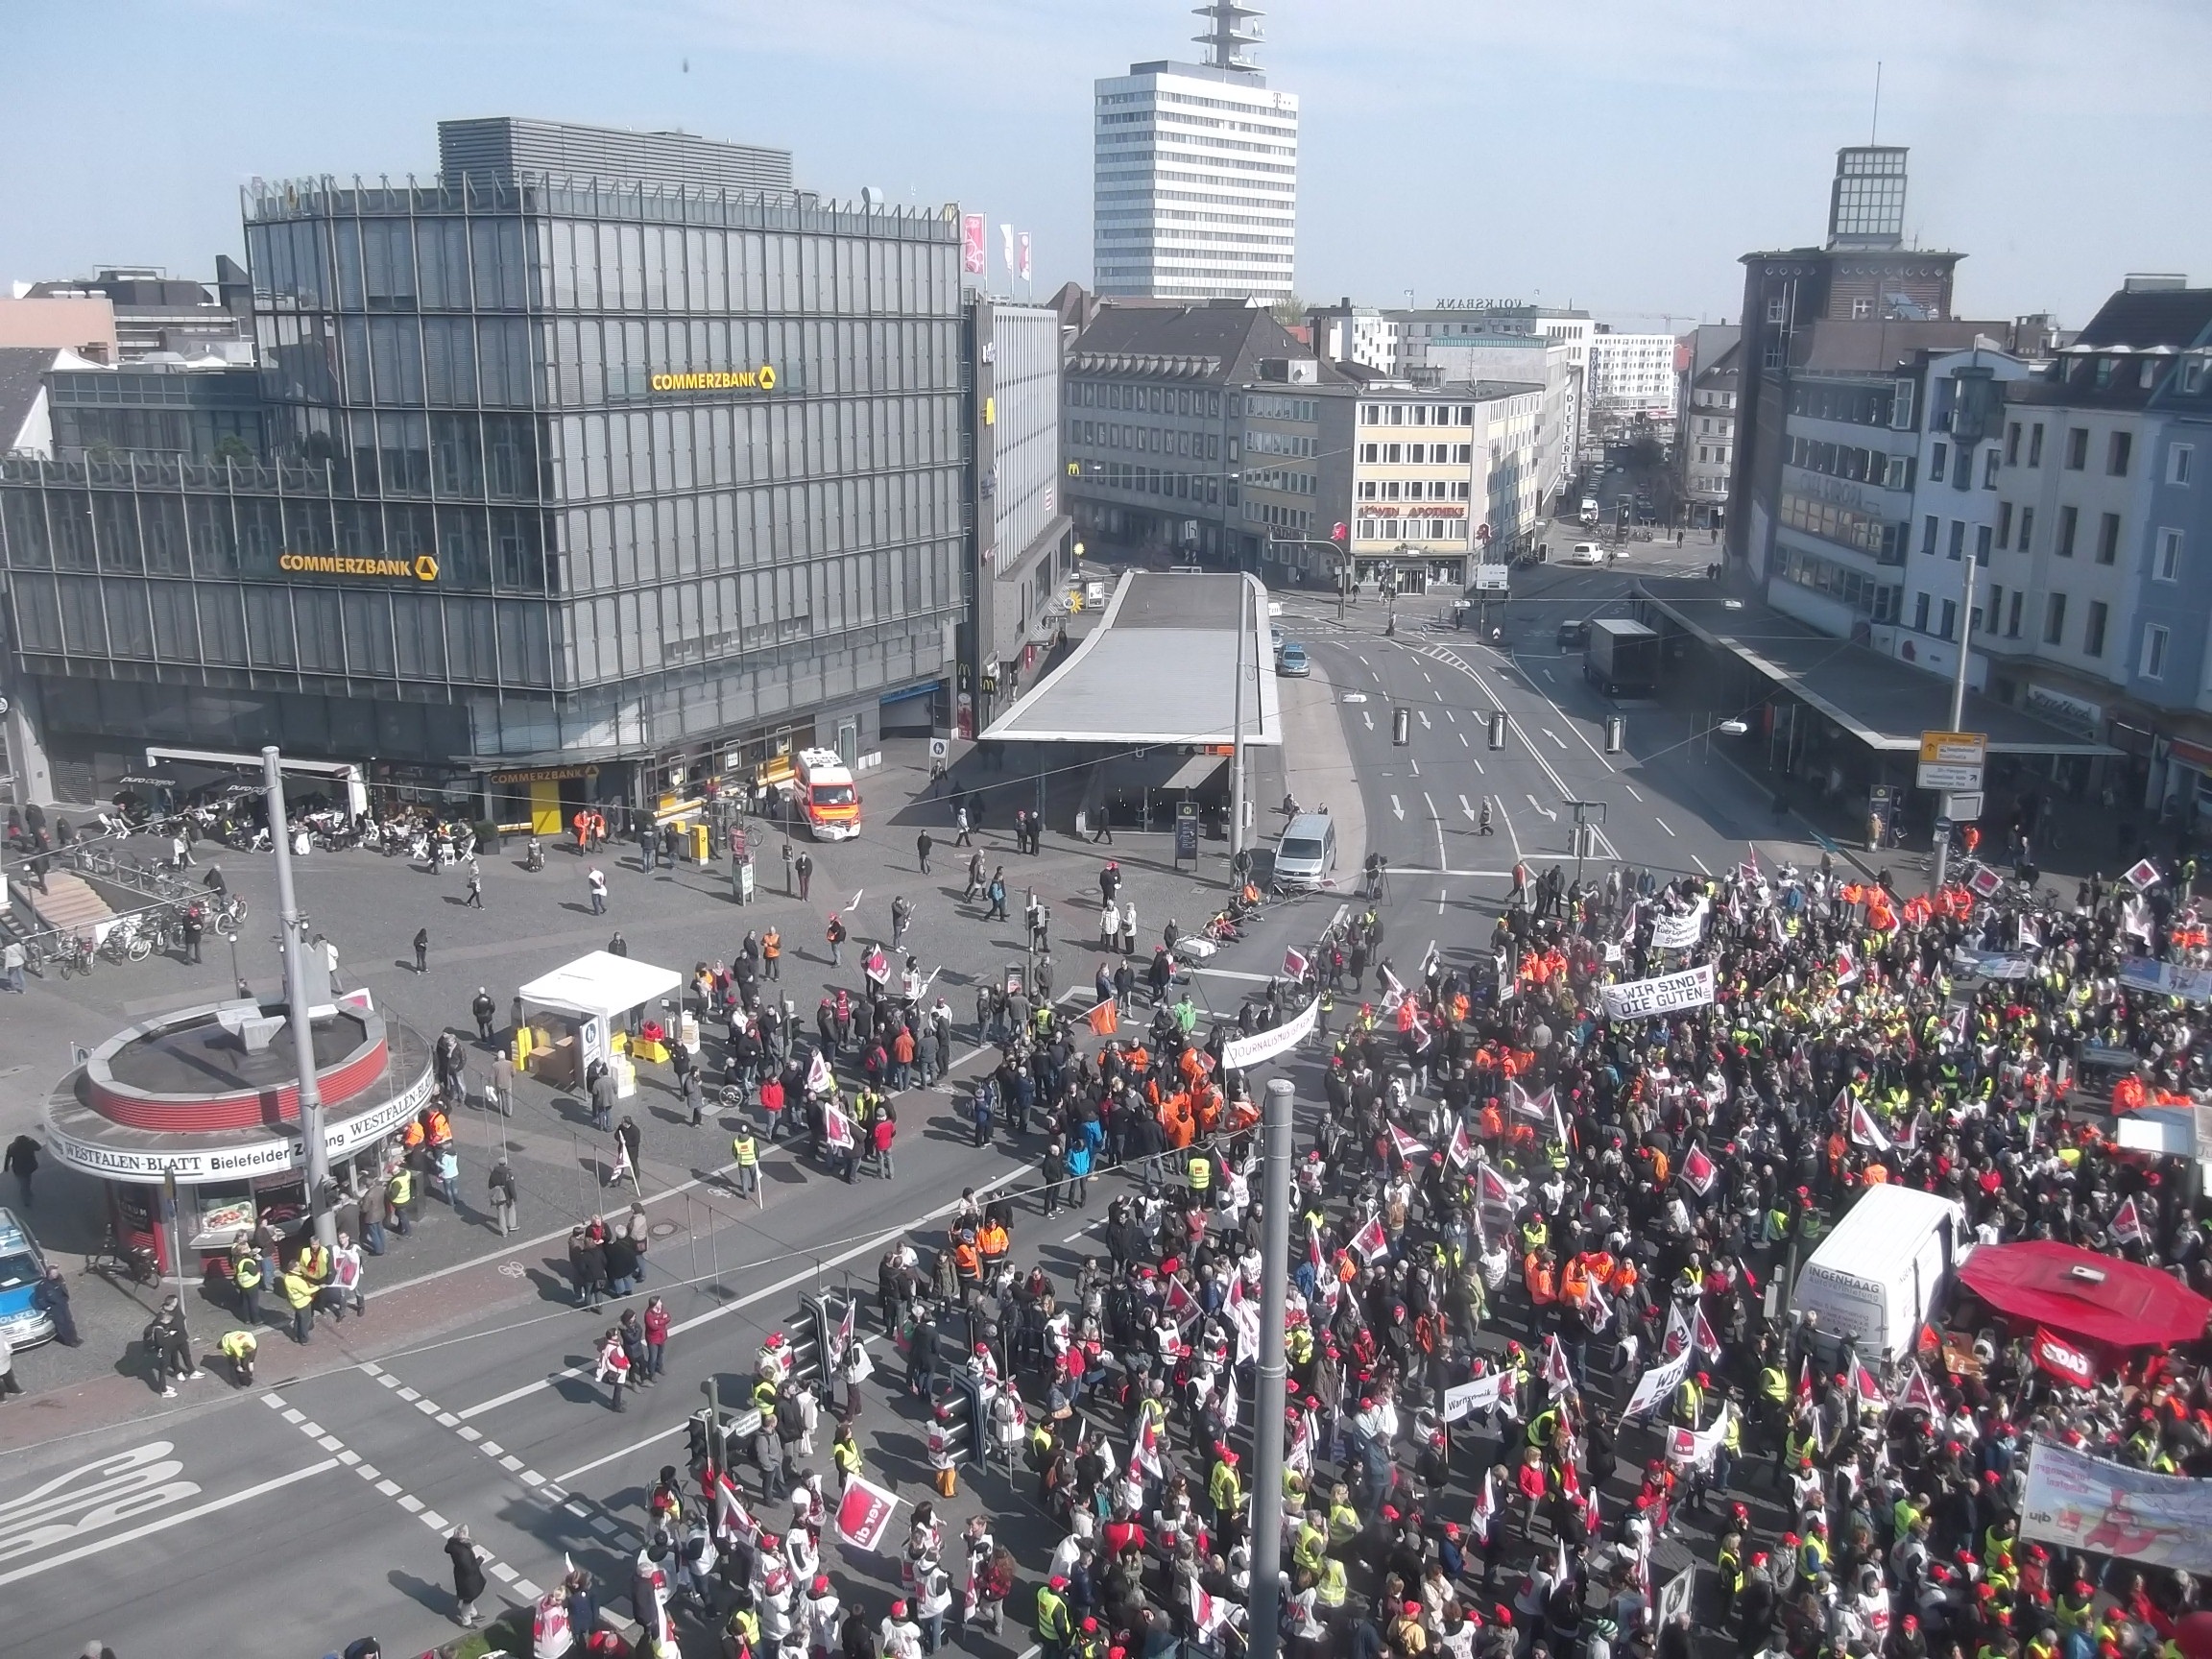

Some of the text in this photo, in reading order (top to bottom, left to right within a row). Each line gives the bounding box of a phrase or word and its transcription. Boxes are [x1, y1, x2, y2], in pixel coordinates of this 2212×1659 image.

[652, 372, 757, 392] COMMERZBANK
[1407, 507, 1465, 518] APOTHEKE
[280, 554, 412, 577] COMMERZBANK
[491, 769, 582, 784] COMMERZBANK
[1623, 975, 1696, 999] WIR SIND
[1622, 998, 1652, 1014] DIE
[1656, 987, 1703, 1007] GUTEN
[1232, 1029, 1289, 1060] JOURNALISMUS
[65, 1142, 202, 1171] WESTFALEN-BLATT
[210, 1146, 291, 1170] Bielefelder
[1810, 1266, 1879, 1293] INGENHAAG
[0, 1309, 37, 1325] OLIZEI
